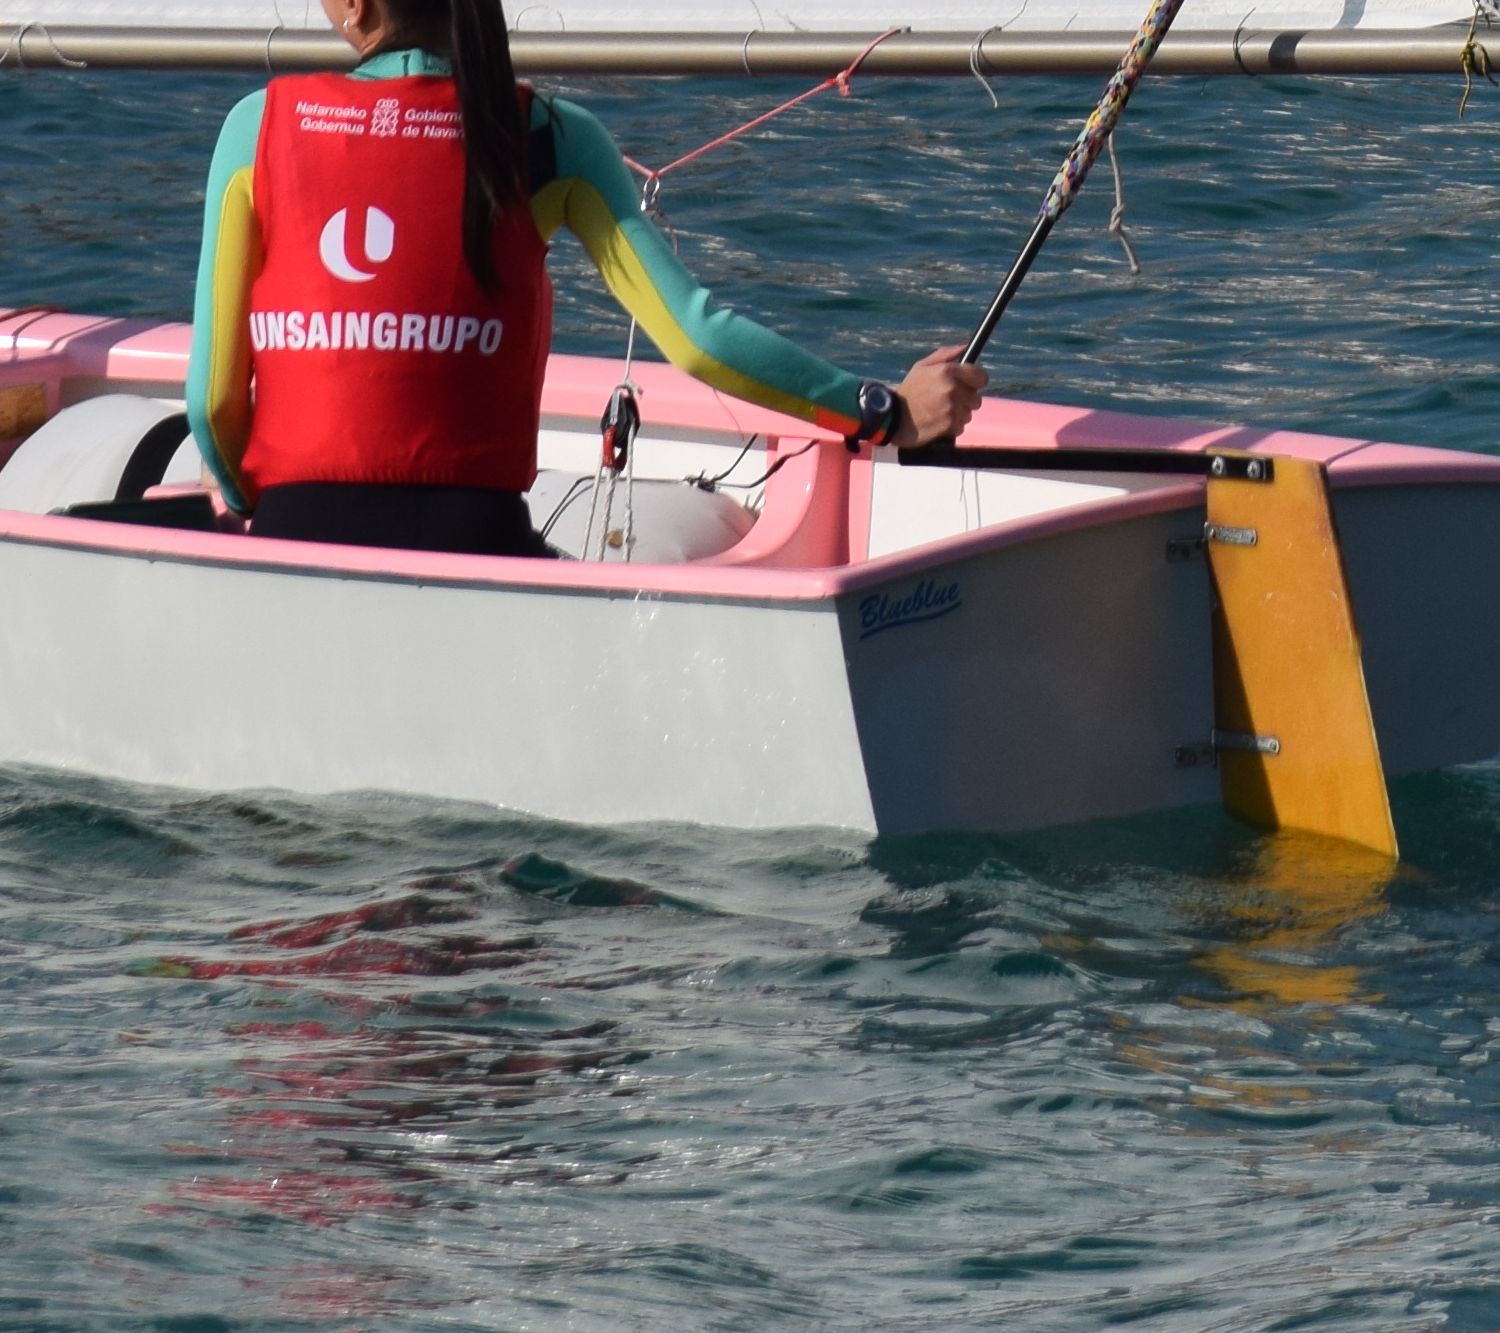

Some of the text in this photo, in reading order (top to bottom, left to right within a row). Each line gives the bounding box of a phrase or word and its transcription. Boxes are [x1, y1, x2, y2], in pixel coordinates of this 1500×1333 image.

[295, 100, 367, 120] Nafarroako
[404, 108, 463, 123] Gobiern
[300, 117, 365, 137] Gobernua
[402, 124, 420, 138] de
[249, 309, 504, 357] UNSAINGRUPO
[859, 579, 960, 628] Blueblue
